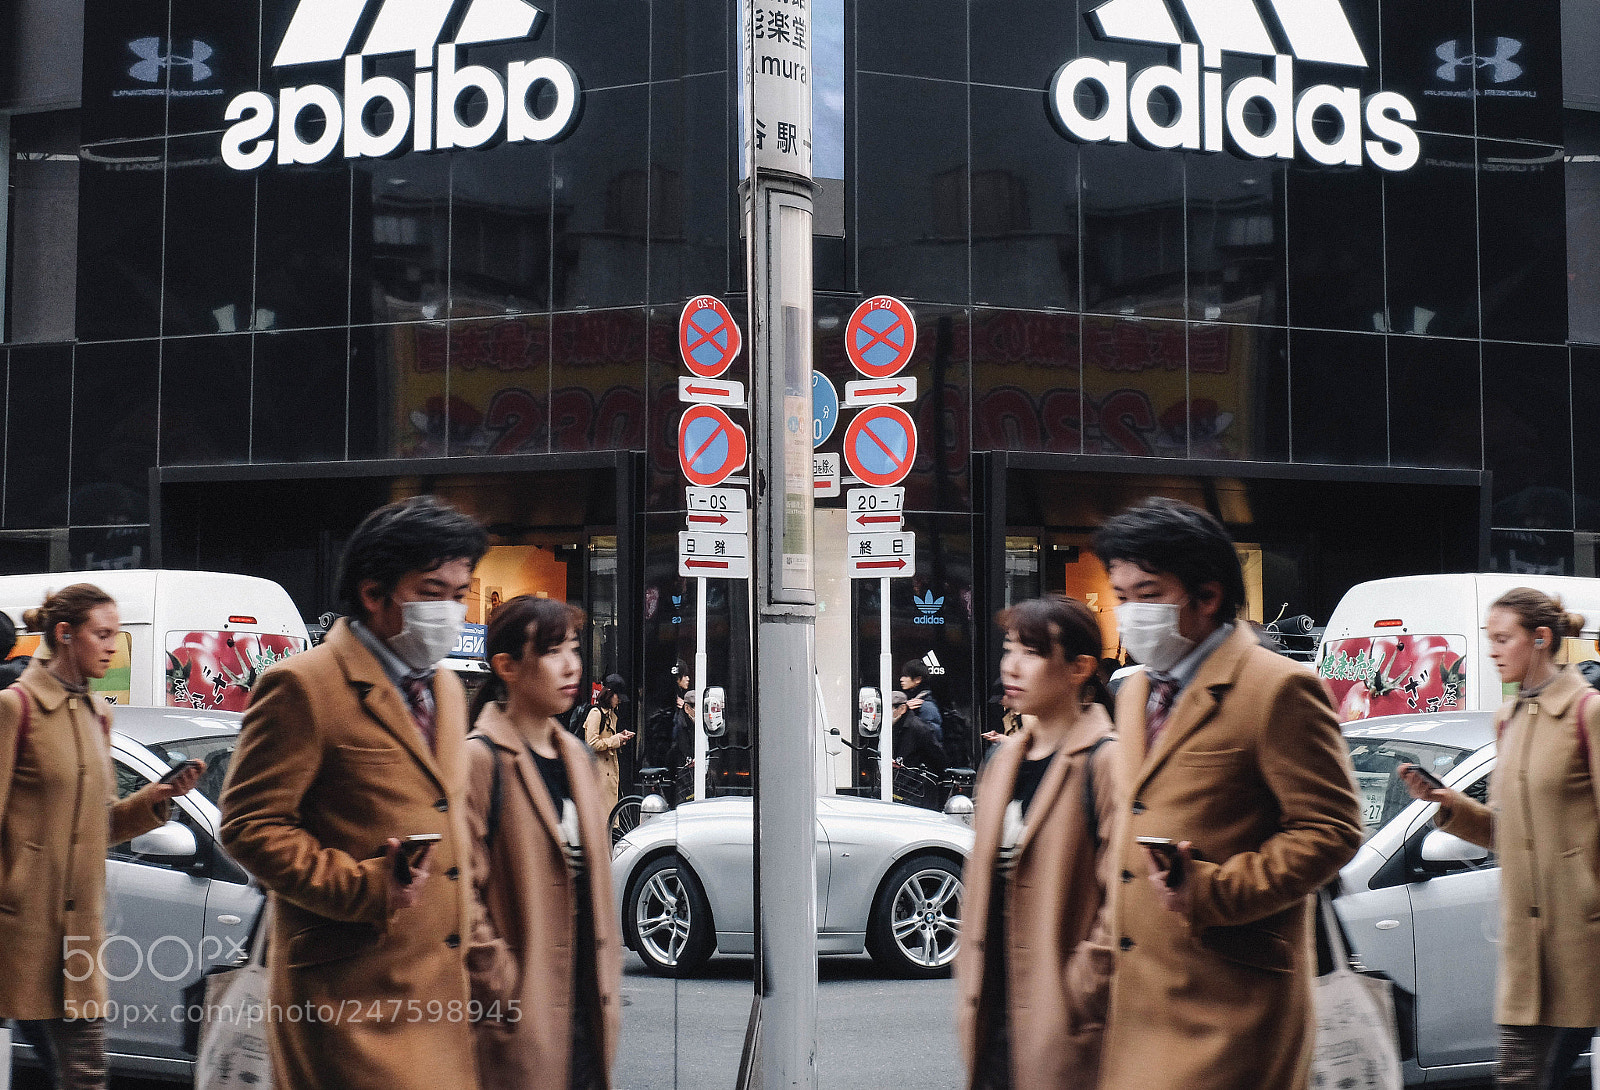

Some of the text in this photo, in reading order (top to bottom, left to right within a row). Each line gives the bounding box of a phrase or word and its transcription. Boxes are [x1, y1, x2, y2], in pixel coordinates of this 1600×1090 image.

[756, 55, 807, 85] mura
[1050, 43, 1420, 171] adidas
[868, 299, 892, 310] 7-20
[858, 493, 900, 510] 20-7
[913, 615, 945, 625] adidas
